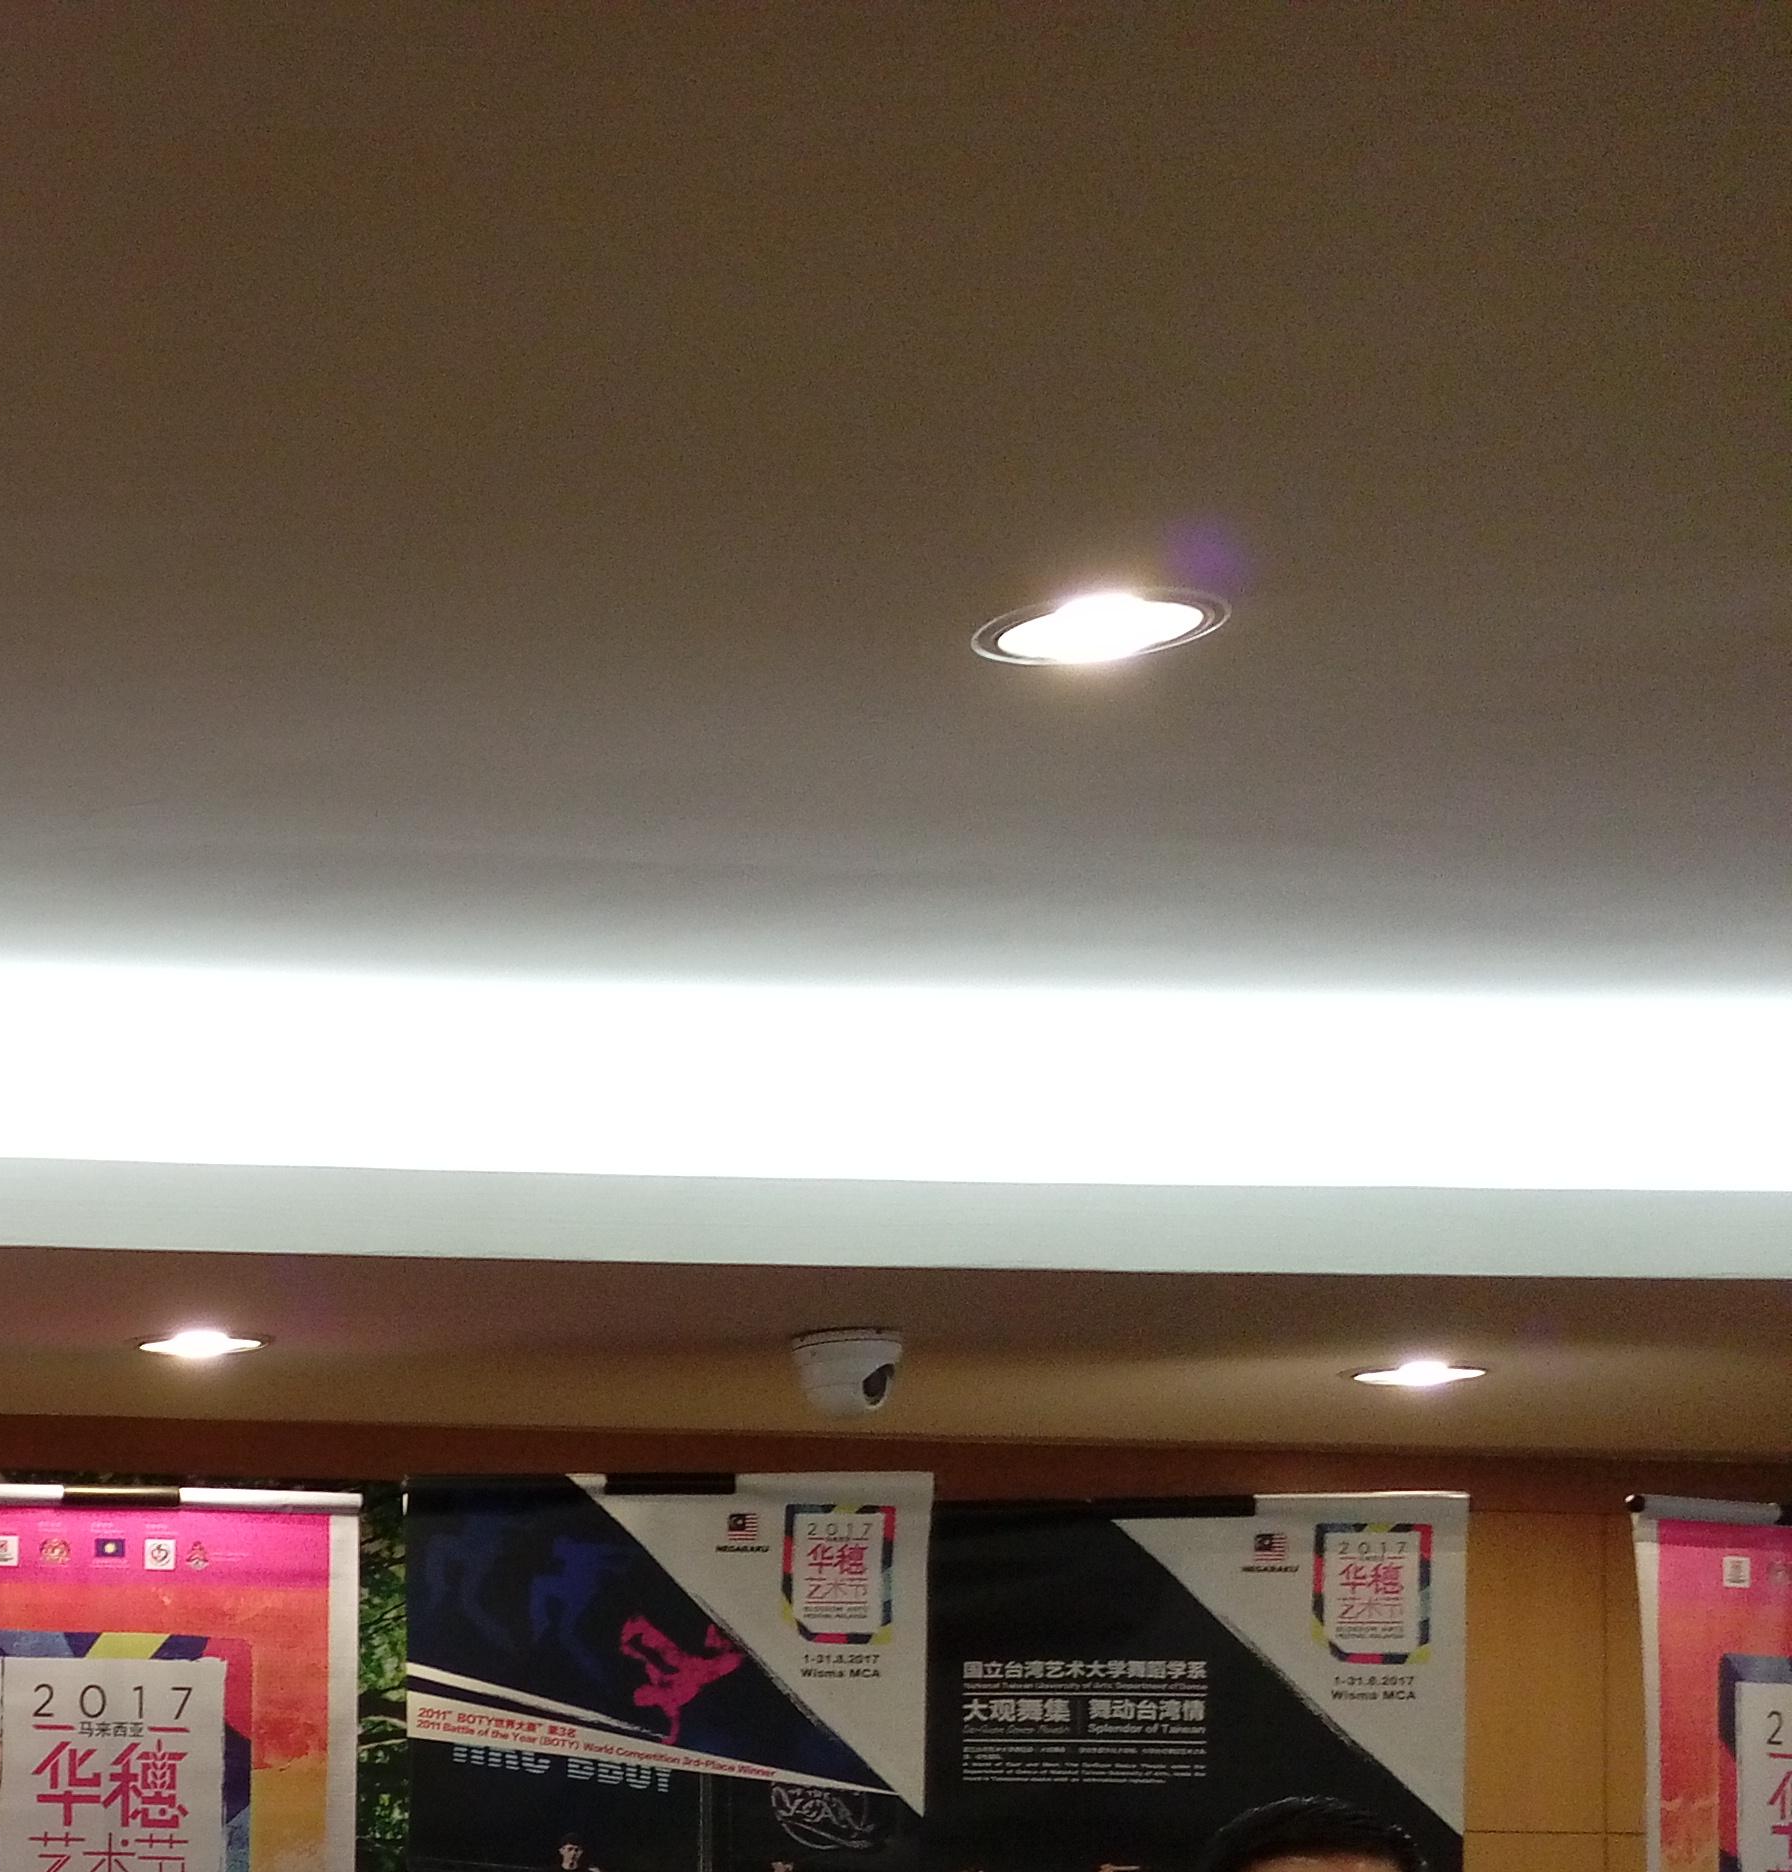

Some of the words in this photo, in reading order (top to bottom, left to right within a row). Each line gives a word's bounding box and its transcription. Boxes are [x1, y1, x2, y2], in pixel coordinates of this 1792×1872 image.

[800, 1666, 844, 1681] Wisma
[847, 1666, 882, 1681] MCA
[78, 1721, 144, 1738] 马来西亚
[31, 1739, 189, 1829] 华穗
